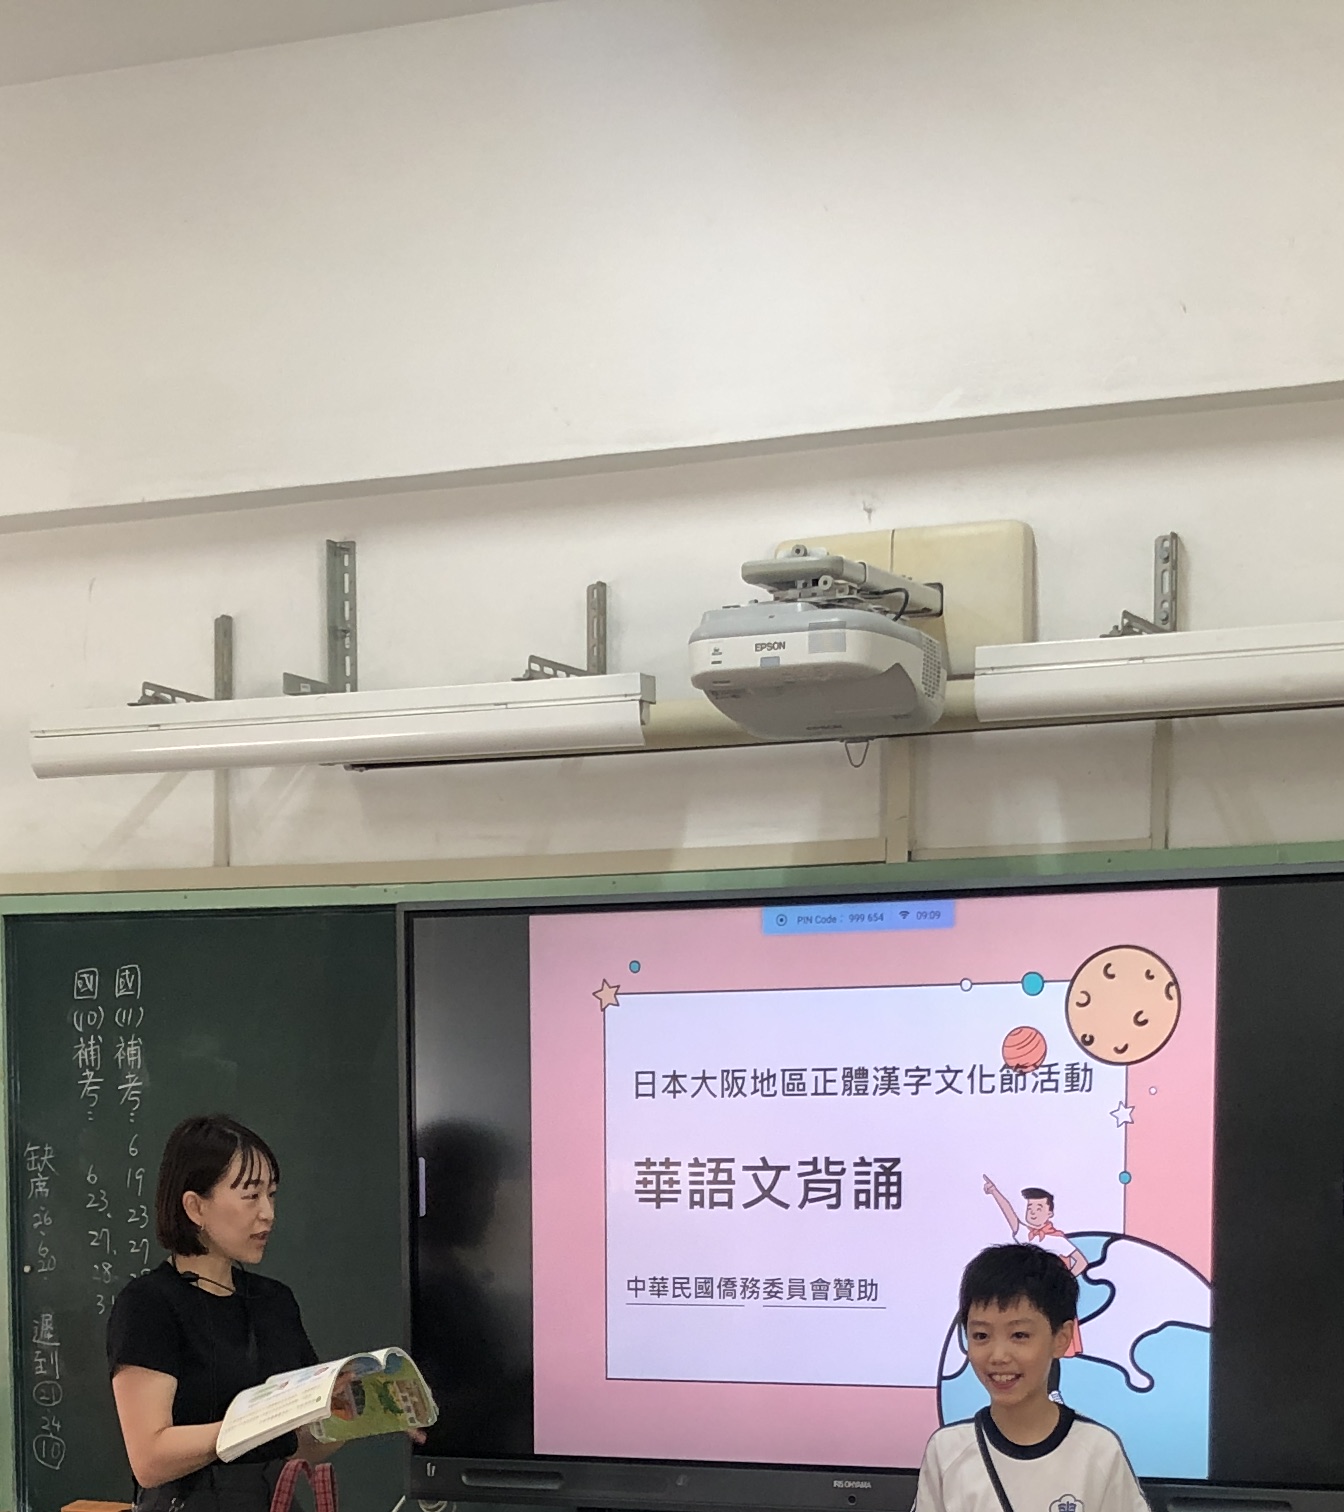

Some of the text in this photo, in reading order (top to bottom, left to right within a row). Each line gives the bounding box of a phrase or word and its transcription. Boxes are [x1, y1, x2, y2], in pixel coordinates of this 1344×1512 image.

[754, 641, 786, 652] EPSON
[797, 914, 813, 925] PIN
[849, 912, 865, 923] 999
[868, 911, 885, 923] 654
[916, 910, 942, 921] 09:09
[632, 1061, 1095, 1100] 日本大阪地區正體漢字文化節活動
[632, 1156, 904, 1212] 華語文背誦
[625, 1274, 879, 1303] 中華民國僑務委員會贊助
